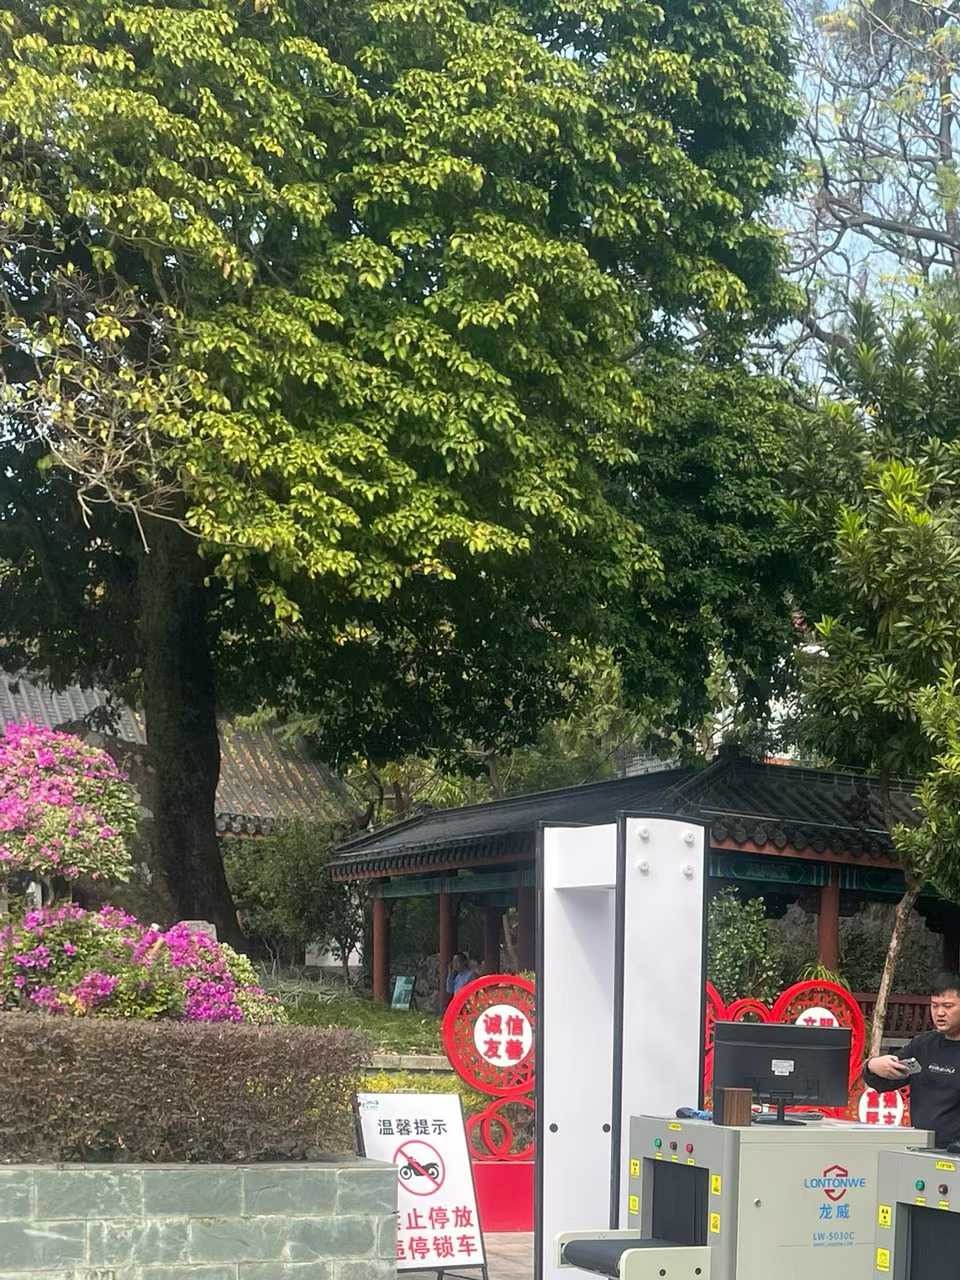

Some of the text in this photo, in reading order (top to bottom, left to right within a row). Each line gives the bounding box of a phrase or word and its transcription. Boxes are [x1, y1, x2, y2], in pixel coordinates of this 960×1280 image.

[378, 1118, 448, 1136] 温馨提示
[804, 1177, 866, 1189] LONTONWE
[397, 1205, 474, 1230] 止停放
[819, 1203, 850, 1220] 龙威
